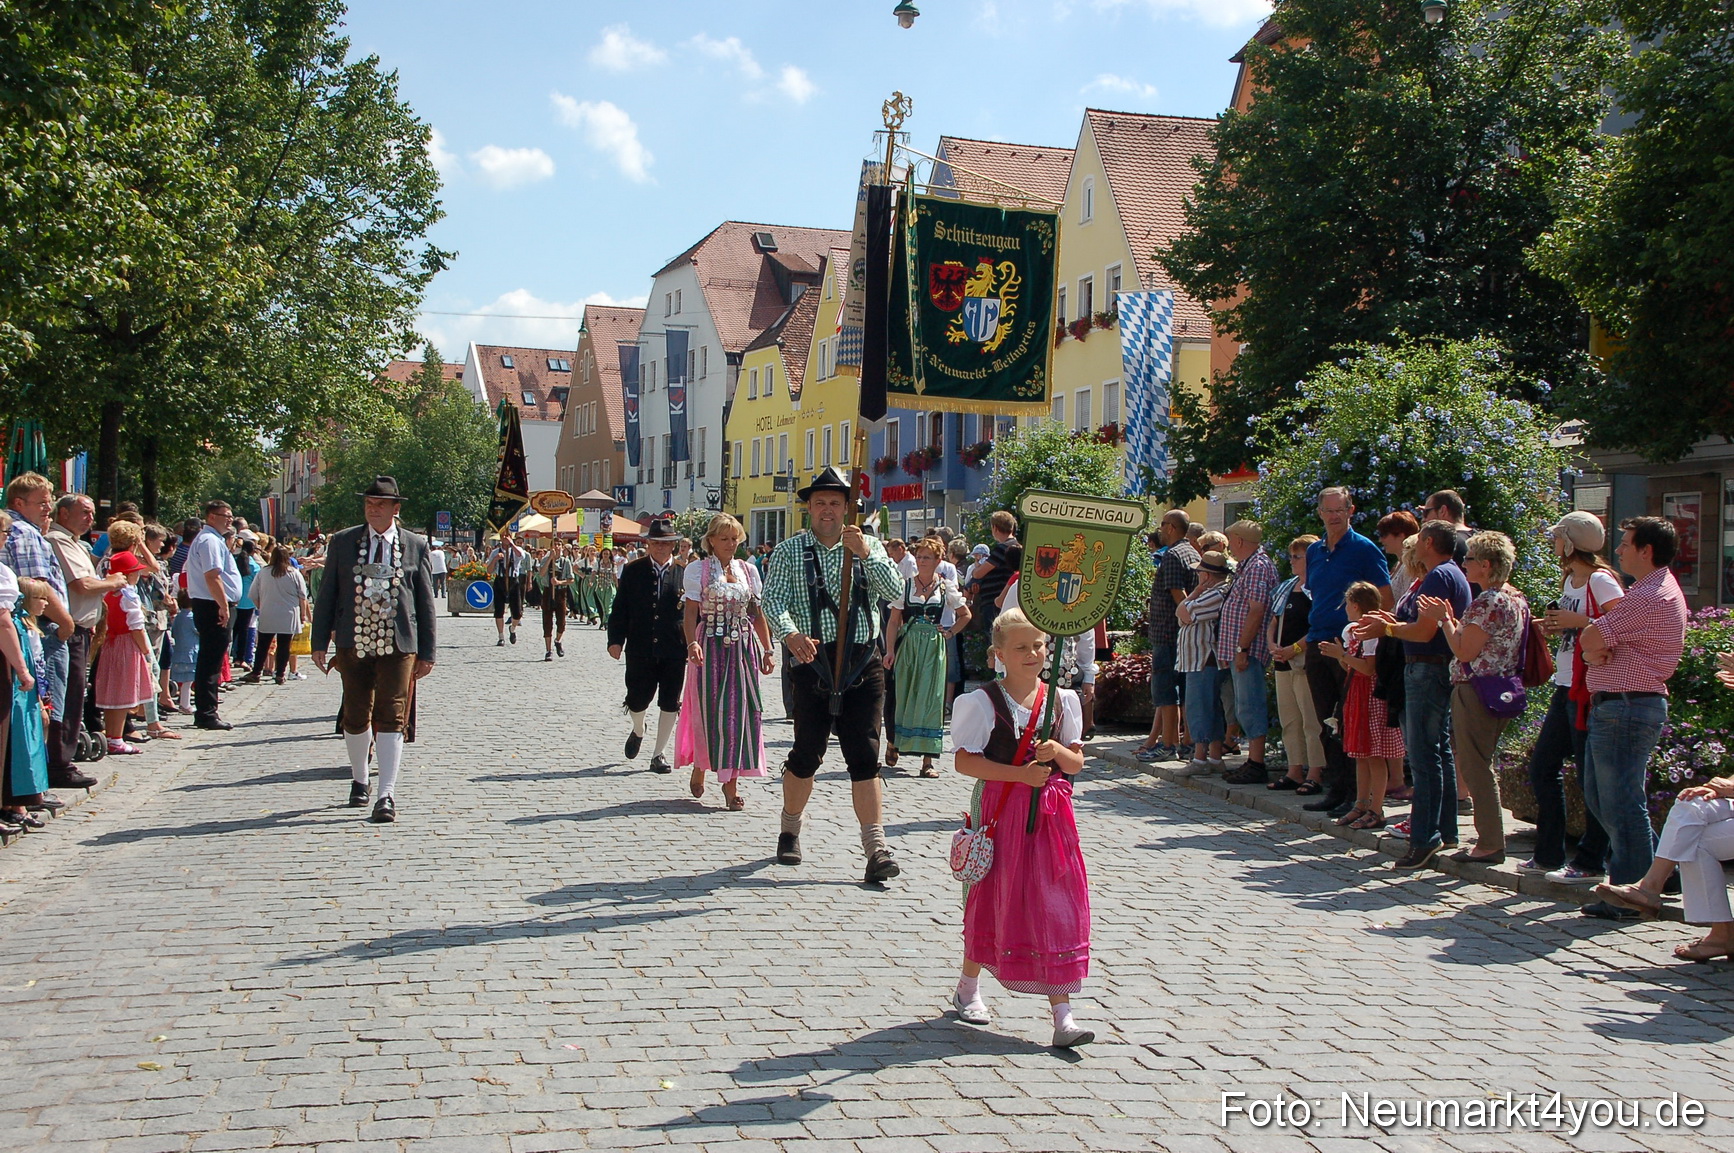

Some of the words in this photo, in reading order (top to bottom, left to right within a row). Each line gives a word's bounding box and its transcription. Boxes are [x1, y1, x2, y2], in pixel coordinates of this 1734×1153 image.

[933, 220, 1021, 253] Schützengau
[756, 415, 773, 432] HOTEL
[1029, 501, 1134, 524] SCHÜTZENGAU
[1022, 554, 1121, 631] ALTDORF-NEUMARKT-BEILNGRIES
